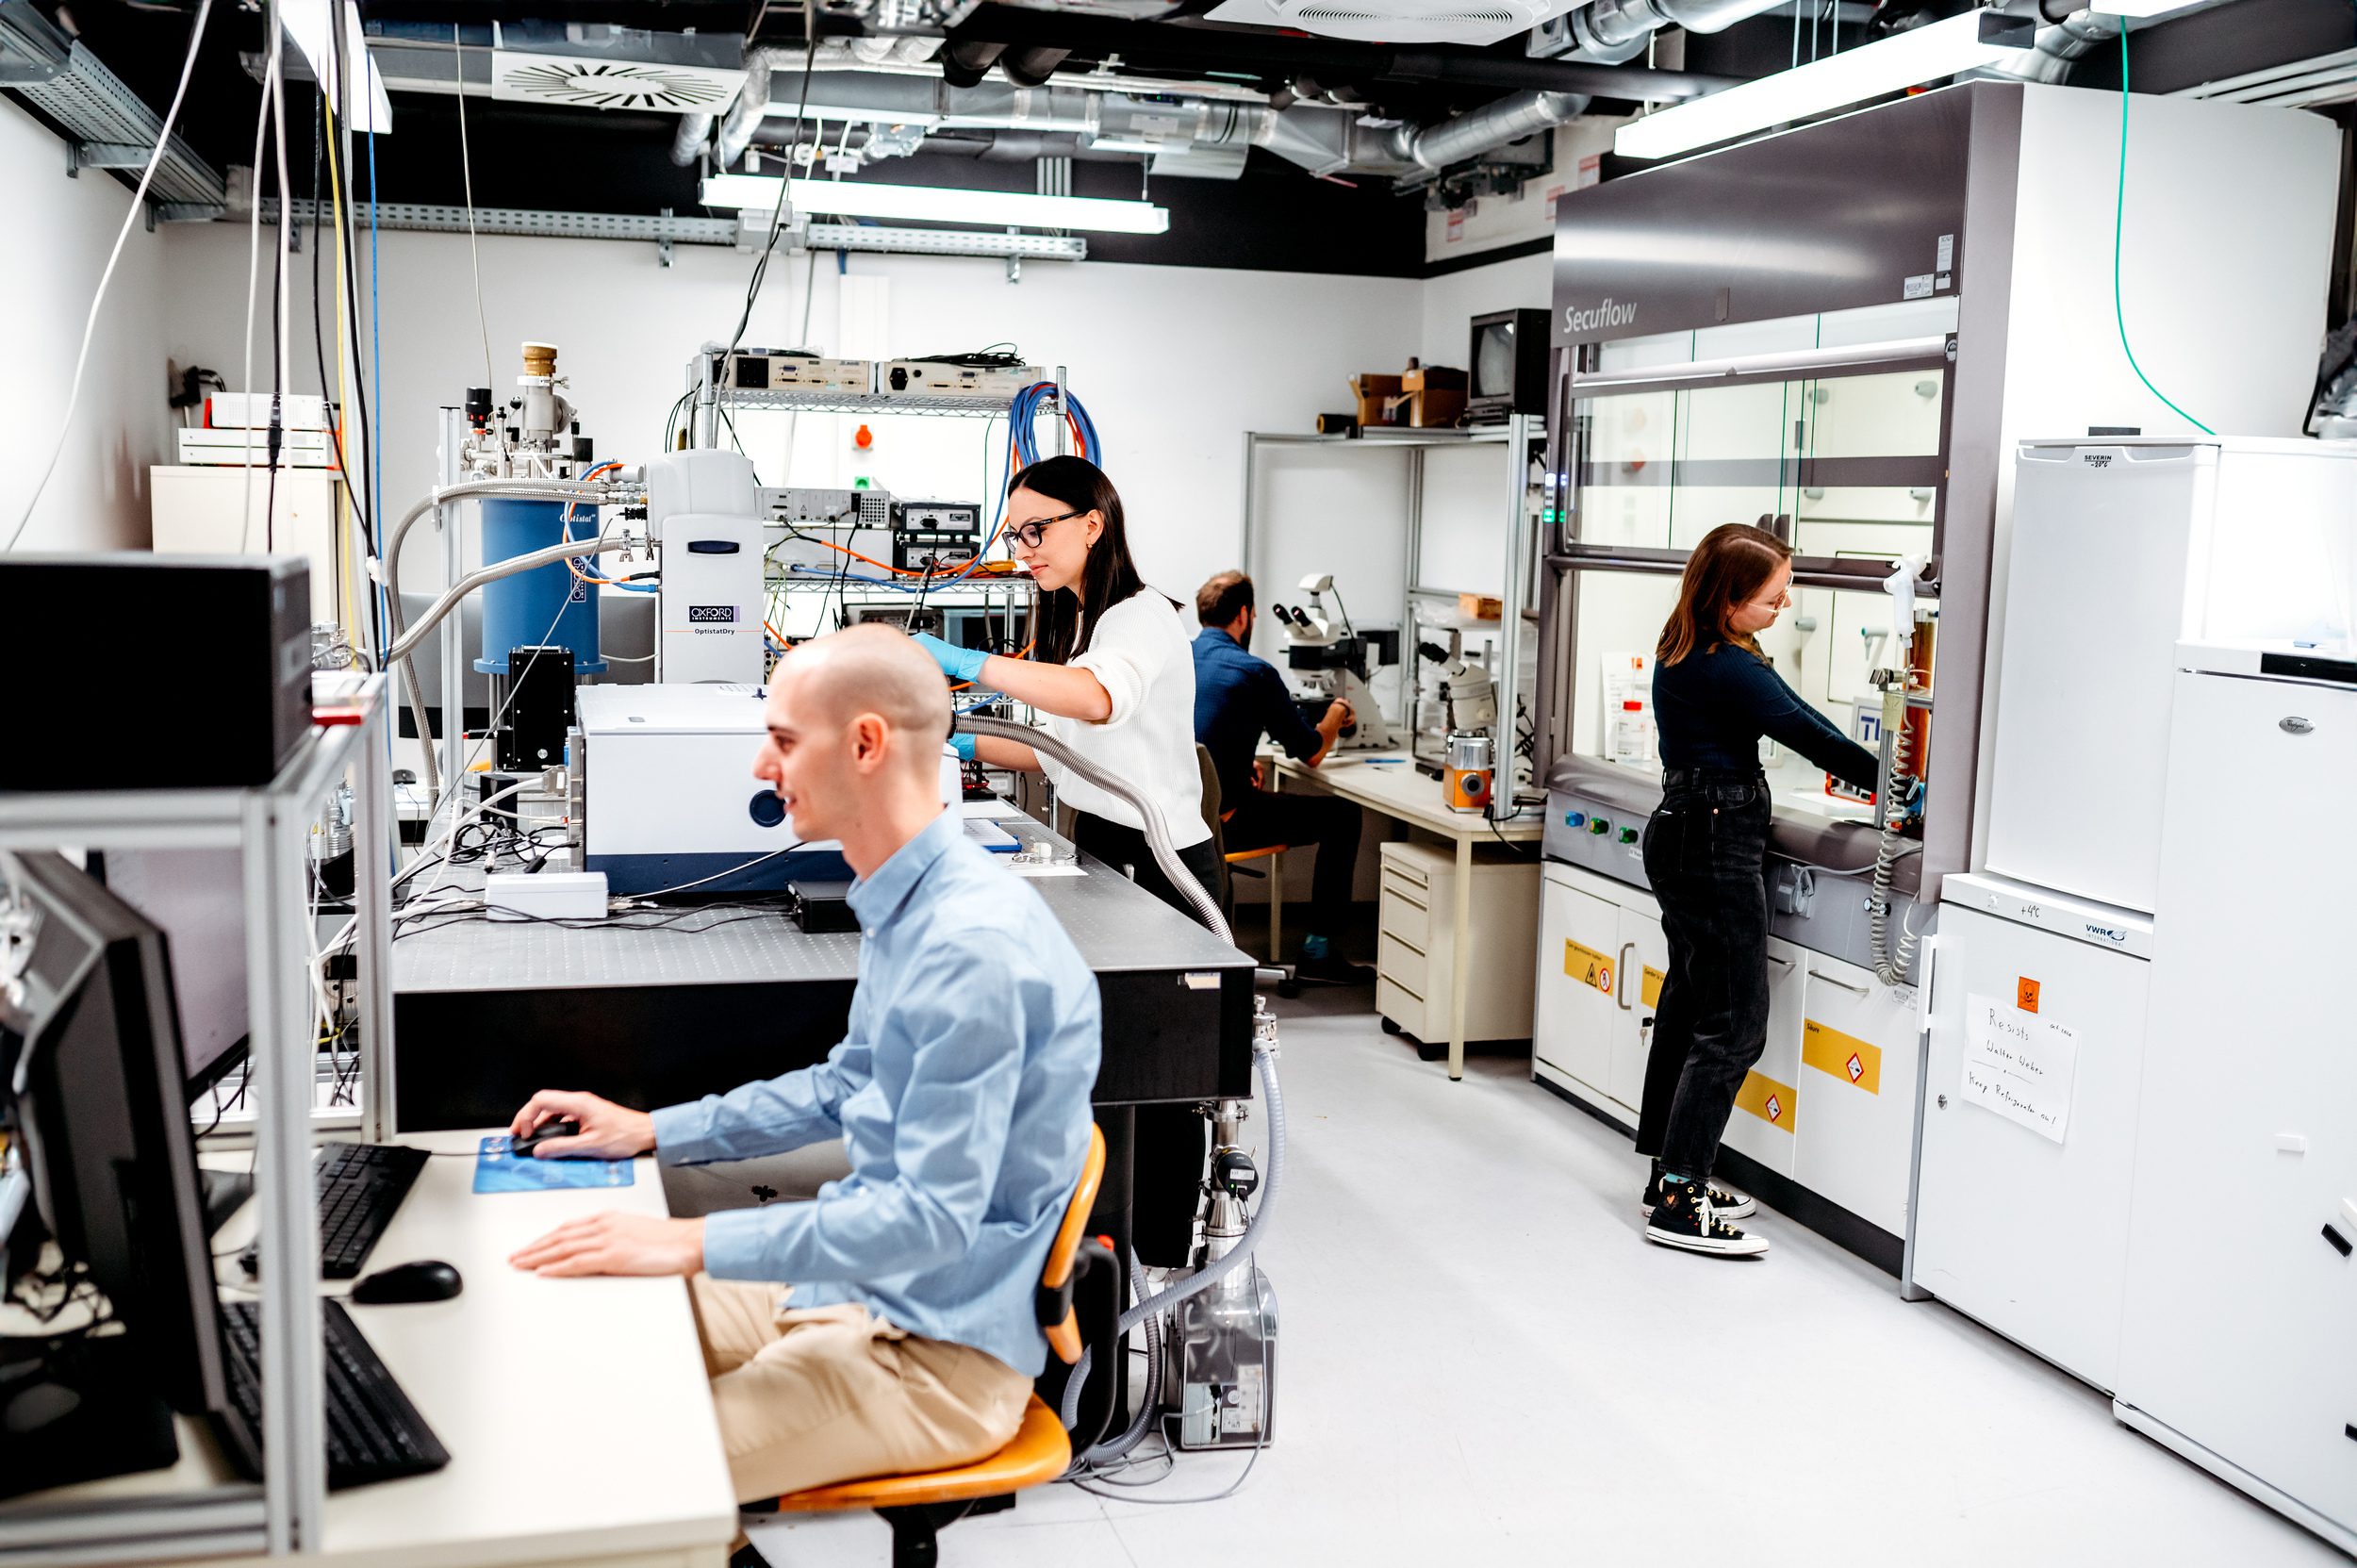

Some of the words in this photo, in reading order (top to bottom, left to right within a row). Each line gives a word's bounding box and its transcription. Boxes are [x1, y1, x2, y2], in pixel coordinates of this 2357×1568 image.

[1563, 297, 1638, 334] Secuflow
[691, 607, 733, 618] OXFORD
[2085, 924, 2106, 936] VWR
[1989, 1008, 2029, 1041] Resists
[1969, 1071, 1987, 1094] Keep
